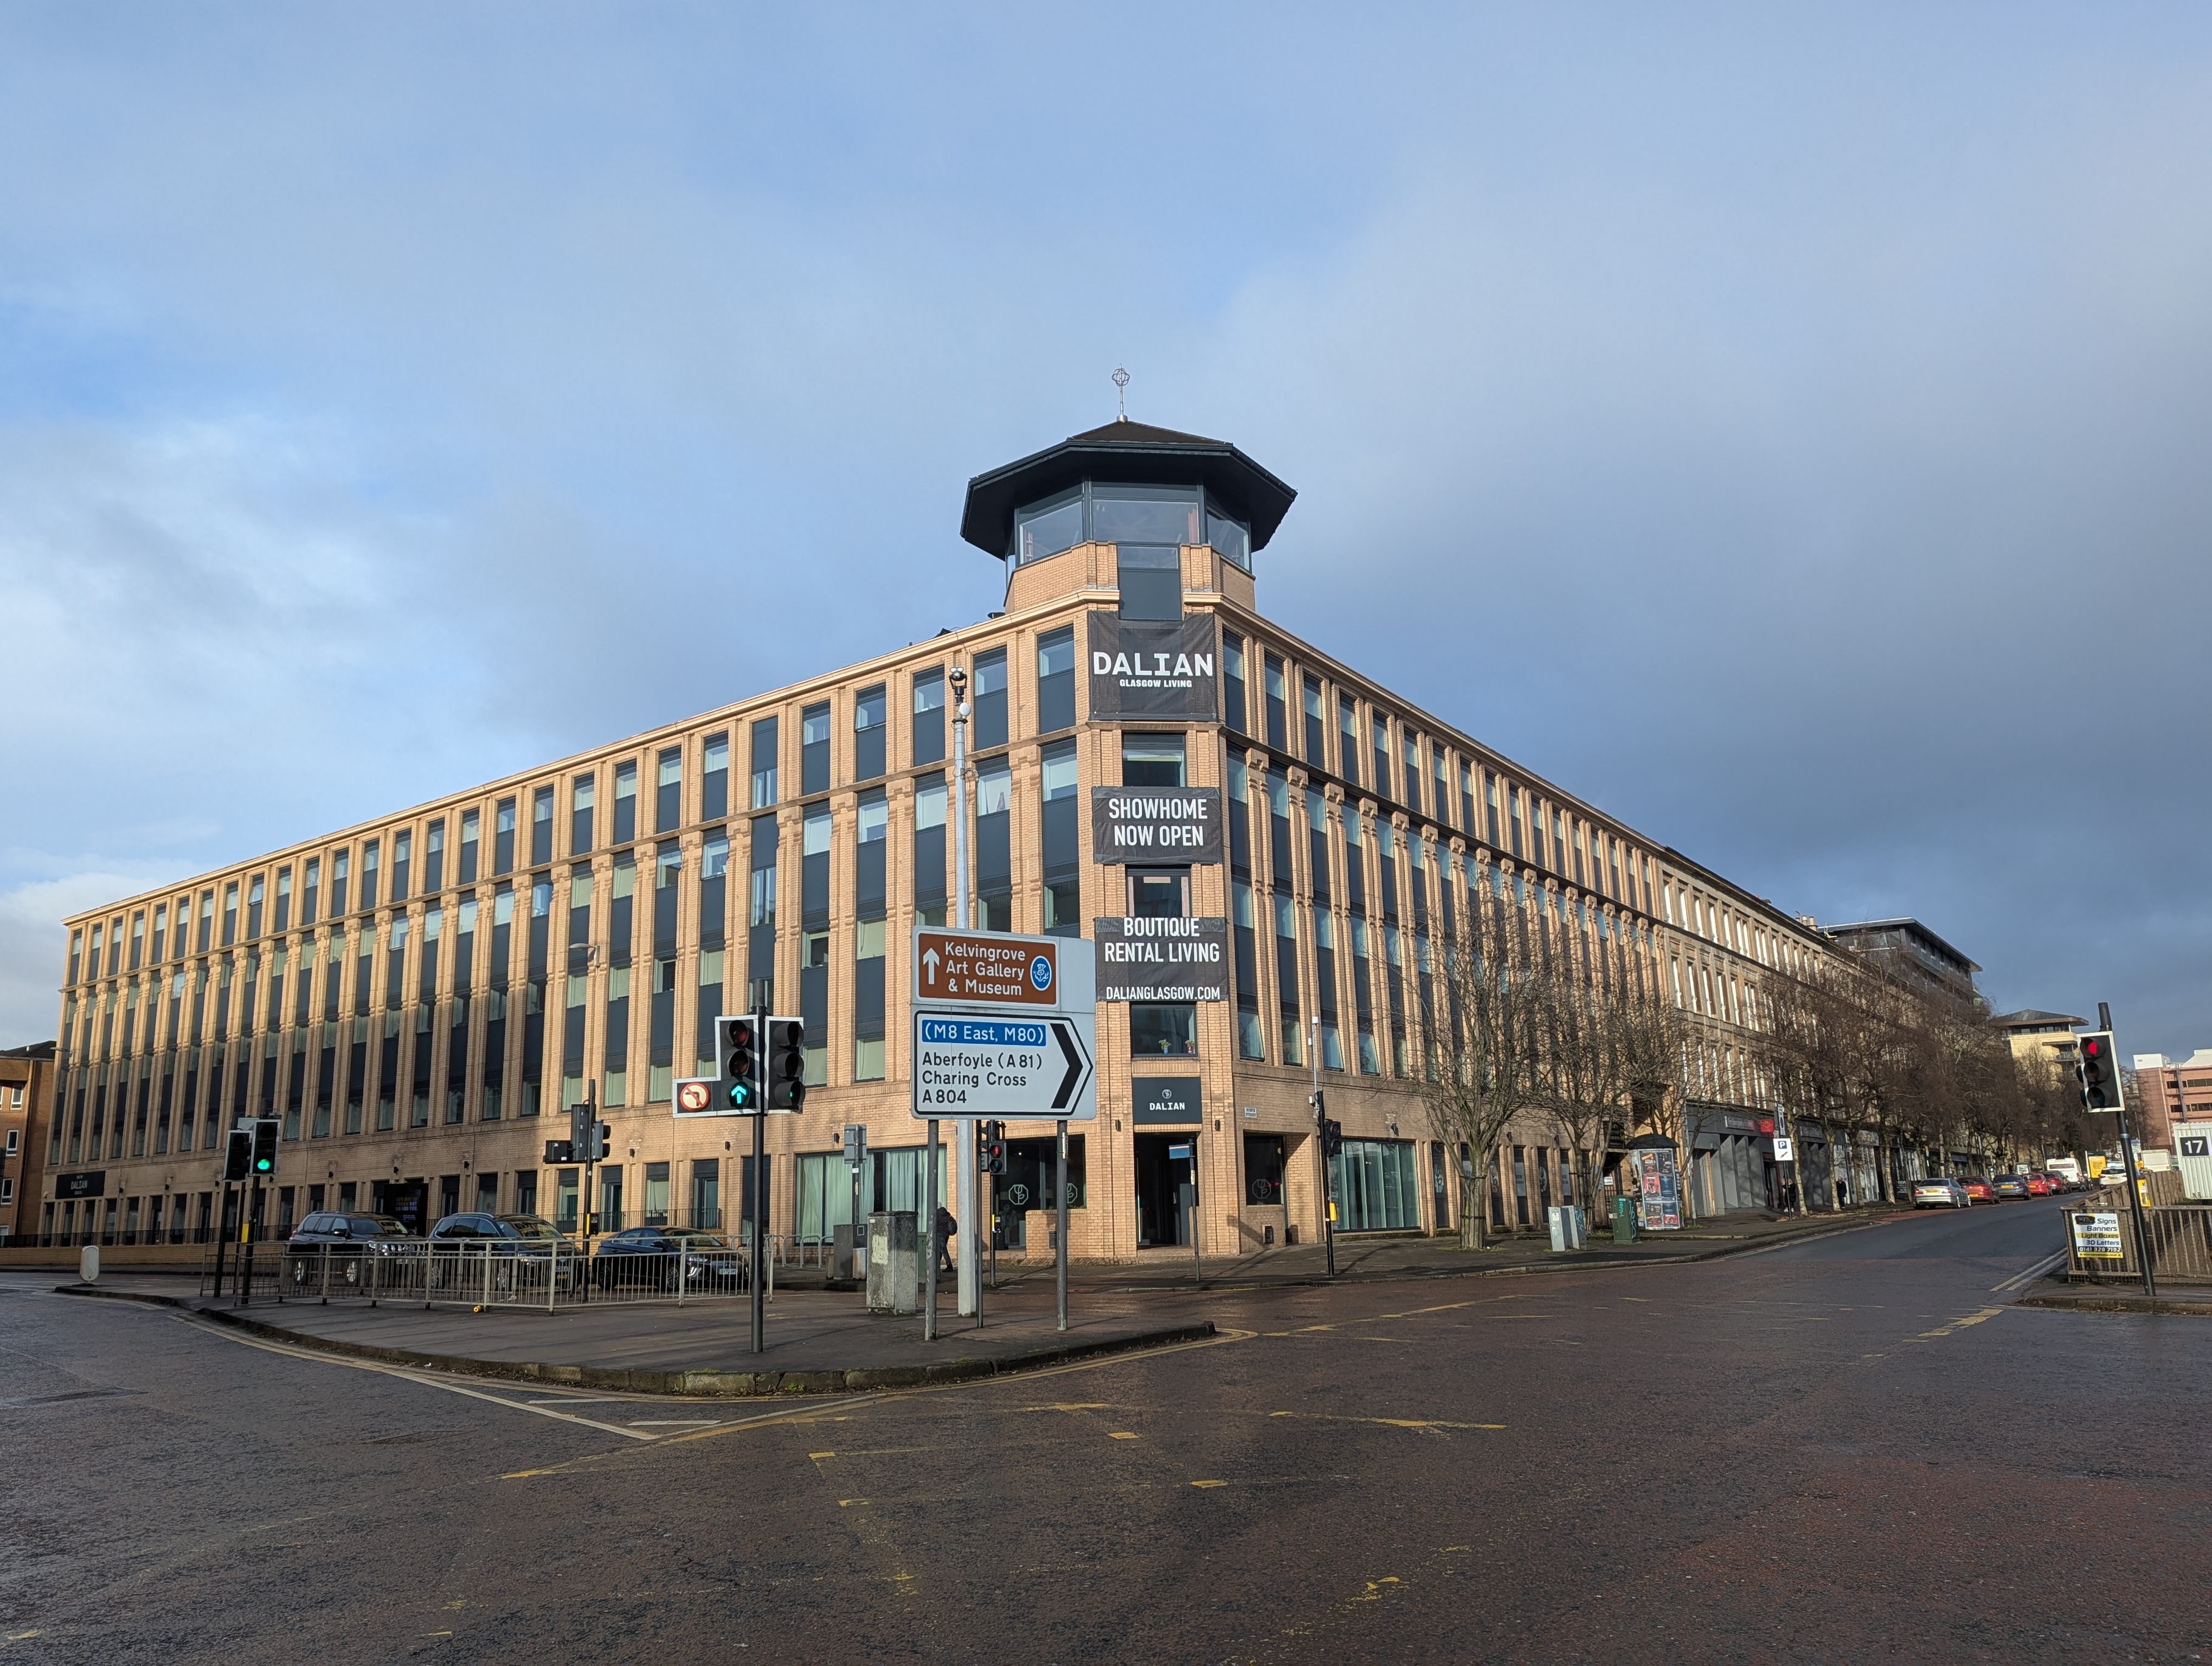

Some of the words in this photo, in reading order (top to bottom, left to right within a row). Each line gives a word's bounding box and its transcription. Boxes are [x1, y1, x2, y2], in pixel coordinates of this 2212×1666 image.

[1093, 651, 1213, 676] DALIAN
[1120, 679, 1161, 687] GLASGOW
[1163, 680, 1192, 688] LIVING
[1109, 798, 1207, 819] SHOWHOME
[1114, 825, 1153, 846] NOW
[1159, 826, 1204, 846] OPEN
[1124, 918, 1200, 937] BOUTIQUE
[946, 941, 1026, 962] Kelvingrove
[1105, 943, 1164, 962] RENTAL
[1169, 943, 1219, 962] LIVING
[946, 959, 968, 975] Art
[975, 962, 1025, 981] Gallery
[948, 978, 958, 993] &
[965, 979, 1022, 996] Museum
[1106, 986, 1220, 1000] DALIANGLASGOW.COM
[925, 1022, 957, 1040] (M8
[964, 1026, 998, 1042] East,
[1005, 1027, 1044, 1045] M80)
[922, 1052, 993, 1071] Aberfoyle
[922, 1071, 979, 1088] Charing
[986, 1073, 1027, 1086] Cross
[922, 1090, 967, 1104] A804
[2185, 1140, 2203, 1154] 17
[70, 1181, 87, 1189] DALIAN
